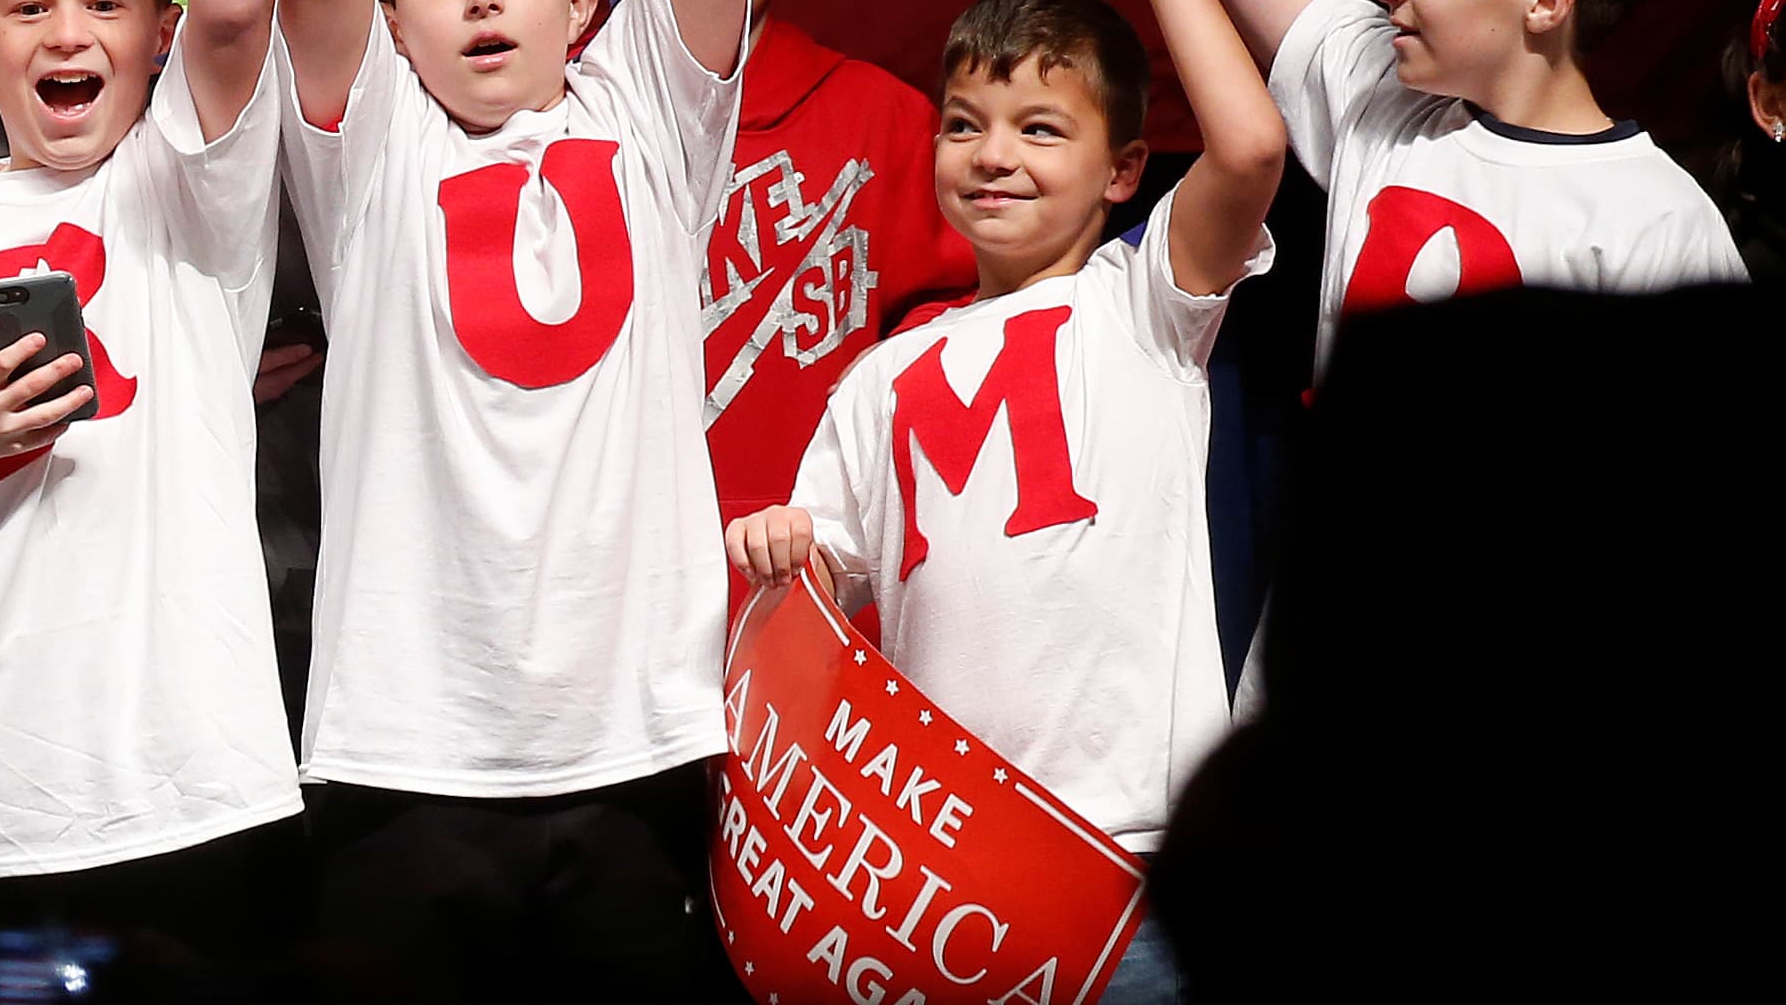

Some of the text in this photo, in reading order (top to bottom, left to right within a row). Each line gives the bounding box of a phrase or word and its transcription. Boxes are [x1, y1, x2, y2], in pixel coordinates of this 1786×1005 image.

[437, 137, 634, 390] U
[892, 305, 1098, 582] M
[724, 668, 1060, 1005] AMERICA
[823, 698, 973, 849] MAKE
